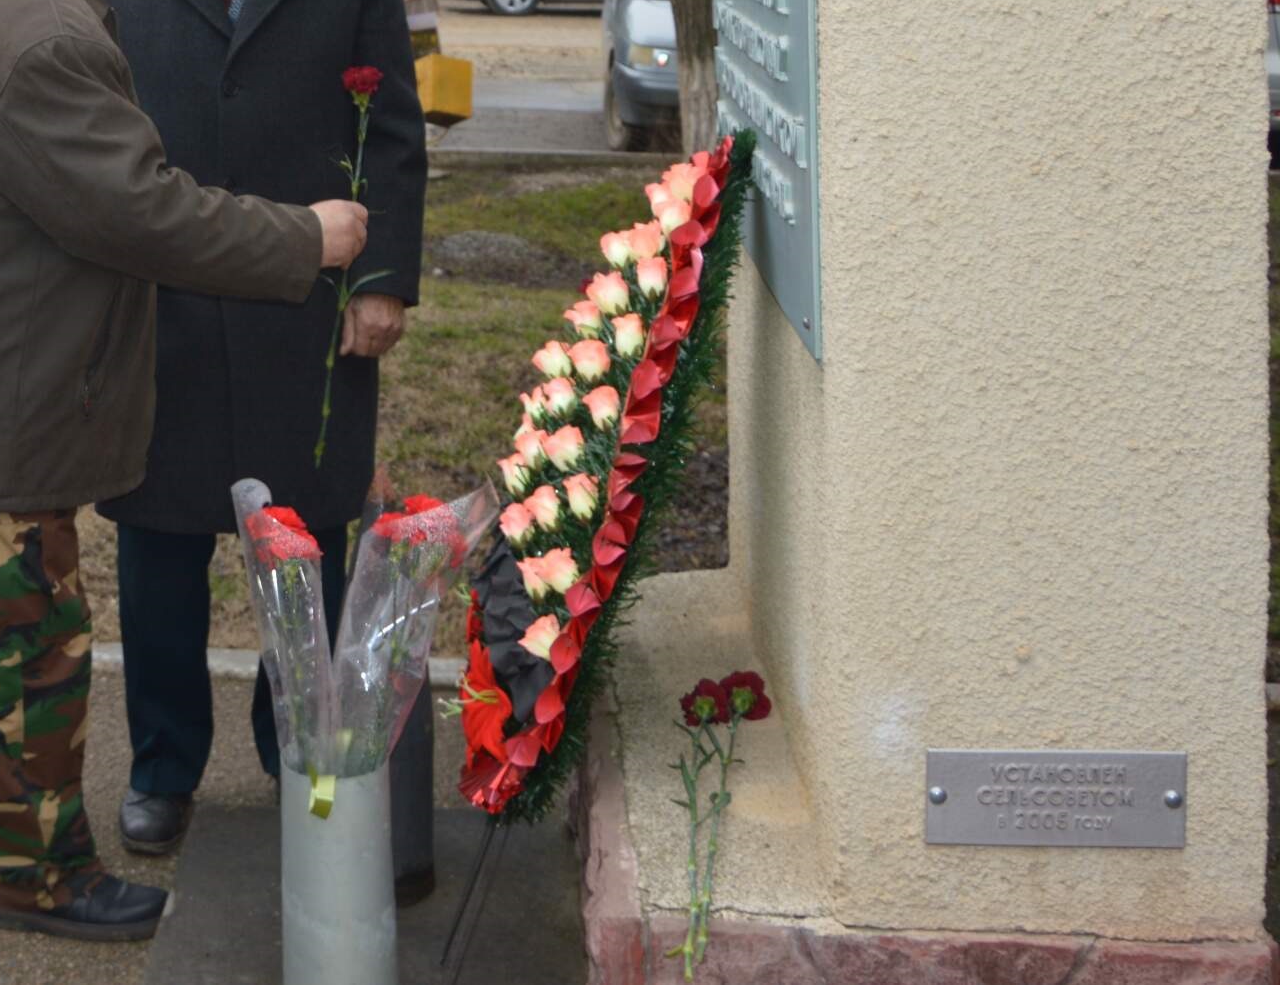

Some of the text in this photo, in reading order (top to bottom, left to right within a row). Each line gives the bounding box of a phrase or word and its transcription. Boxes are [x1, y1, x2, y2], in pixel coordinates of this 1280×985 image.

[990, 763, 1128, 784] УСТАНОВЛЕН
[976, 785, 1135, 807] СЕЛЬСОВЕТОМ
[1074, 815, 1113, 831] году
